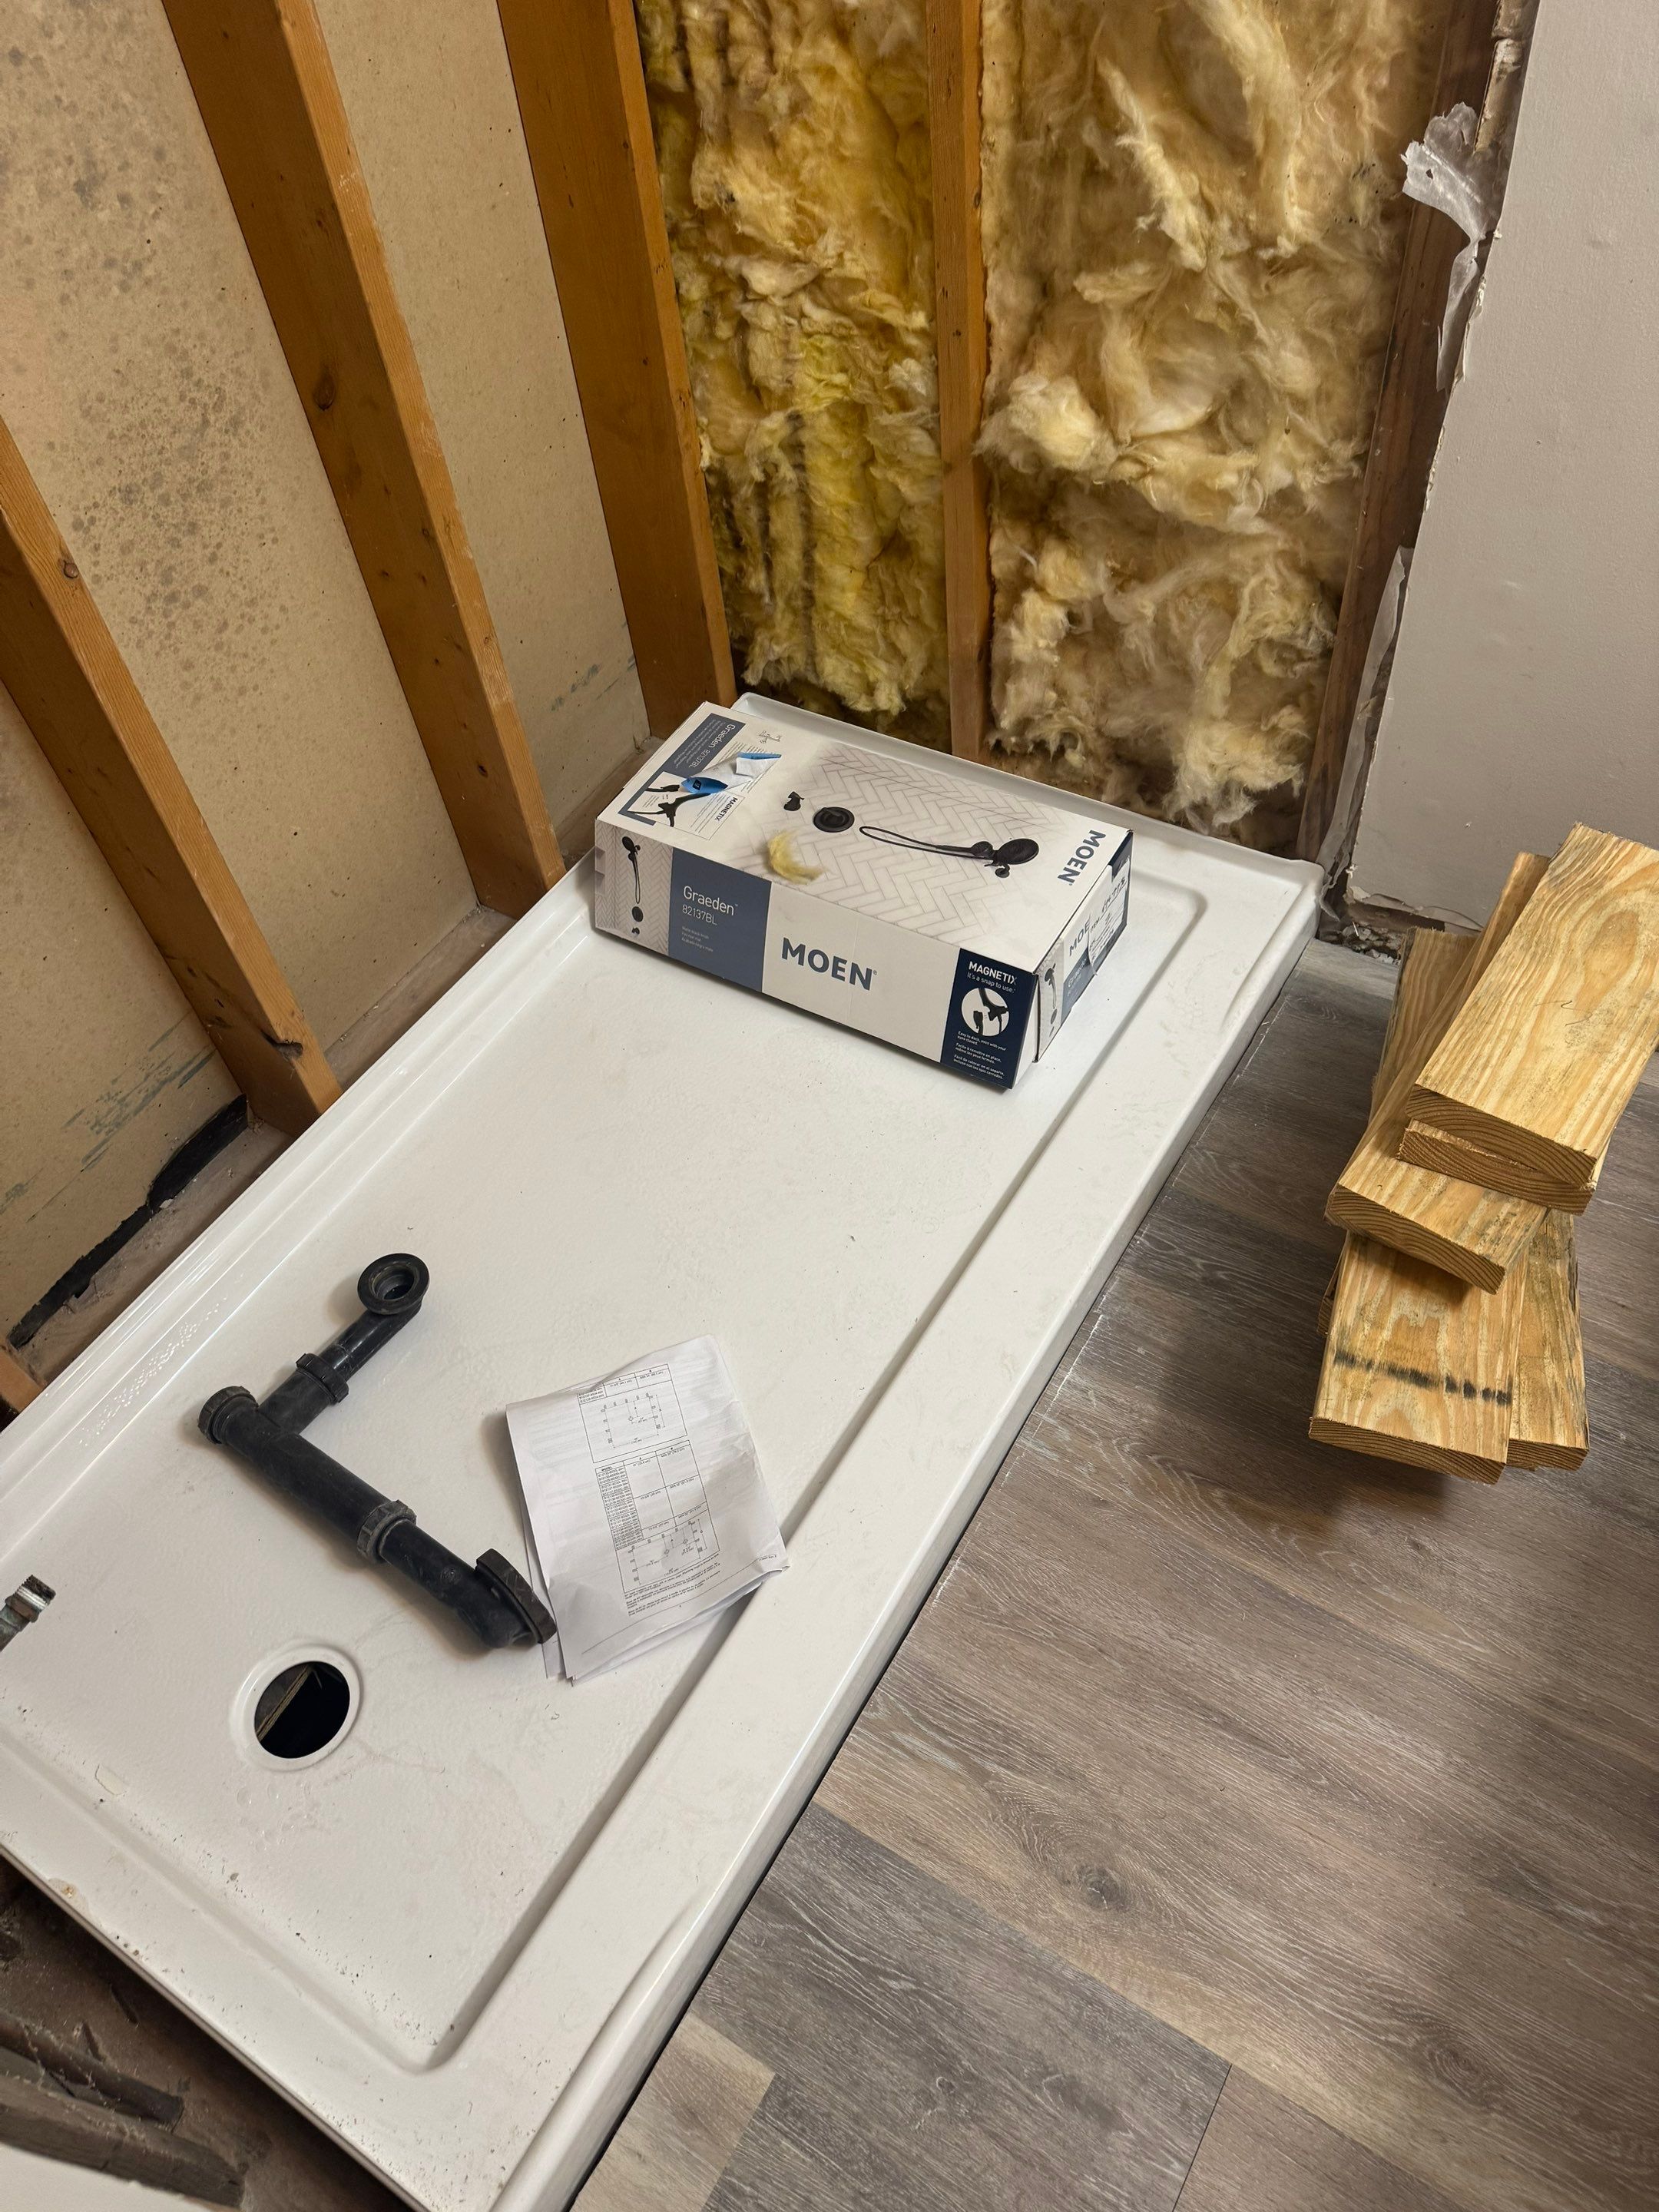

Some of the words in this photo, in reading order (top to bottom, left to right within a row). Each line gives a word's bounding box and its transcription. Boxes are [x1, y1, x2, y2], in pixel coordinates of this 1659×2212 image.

[708, 724, 736, 748] Graeden
[715, 796, 738, 821] MAGNETIX
[684, 886, 735, 916] Graeden
[682, 904, 717, 926] 82137BL
[1068, 920, 1090, 957] MOE
[967, 972, 975, 980] It's
[981, 978, 995, 987] snap
[969, 961, 1017, 985] MAGNETIX
